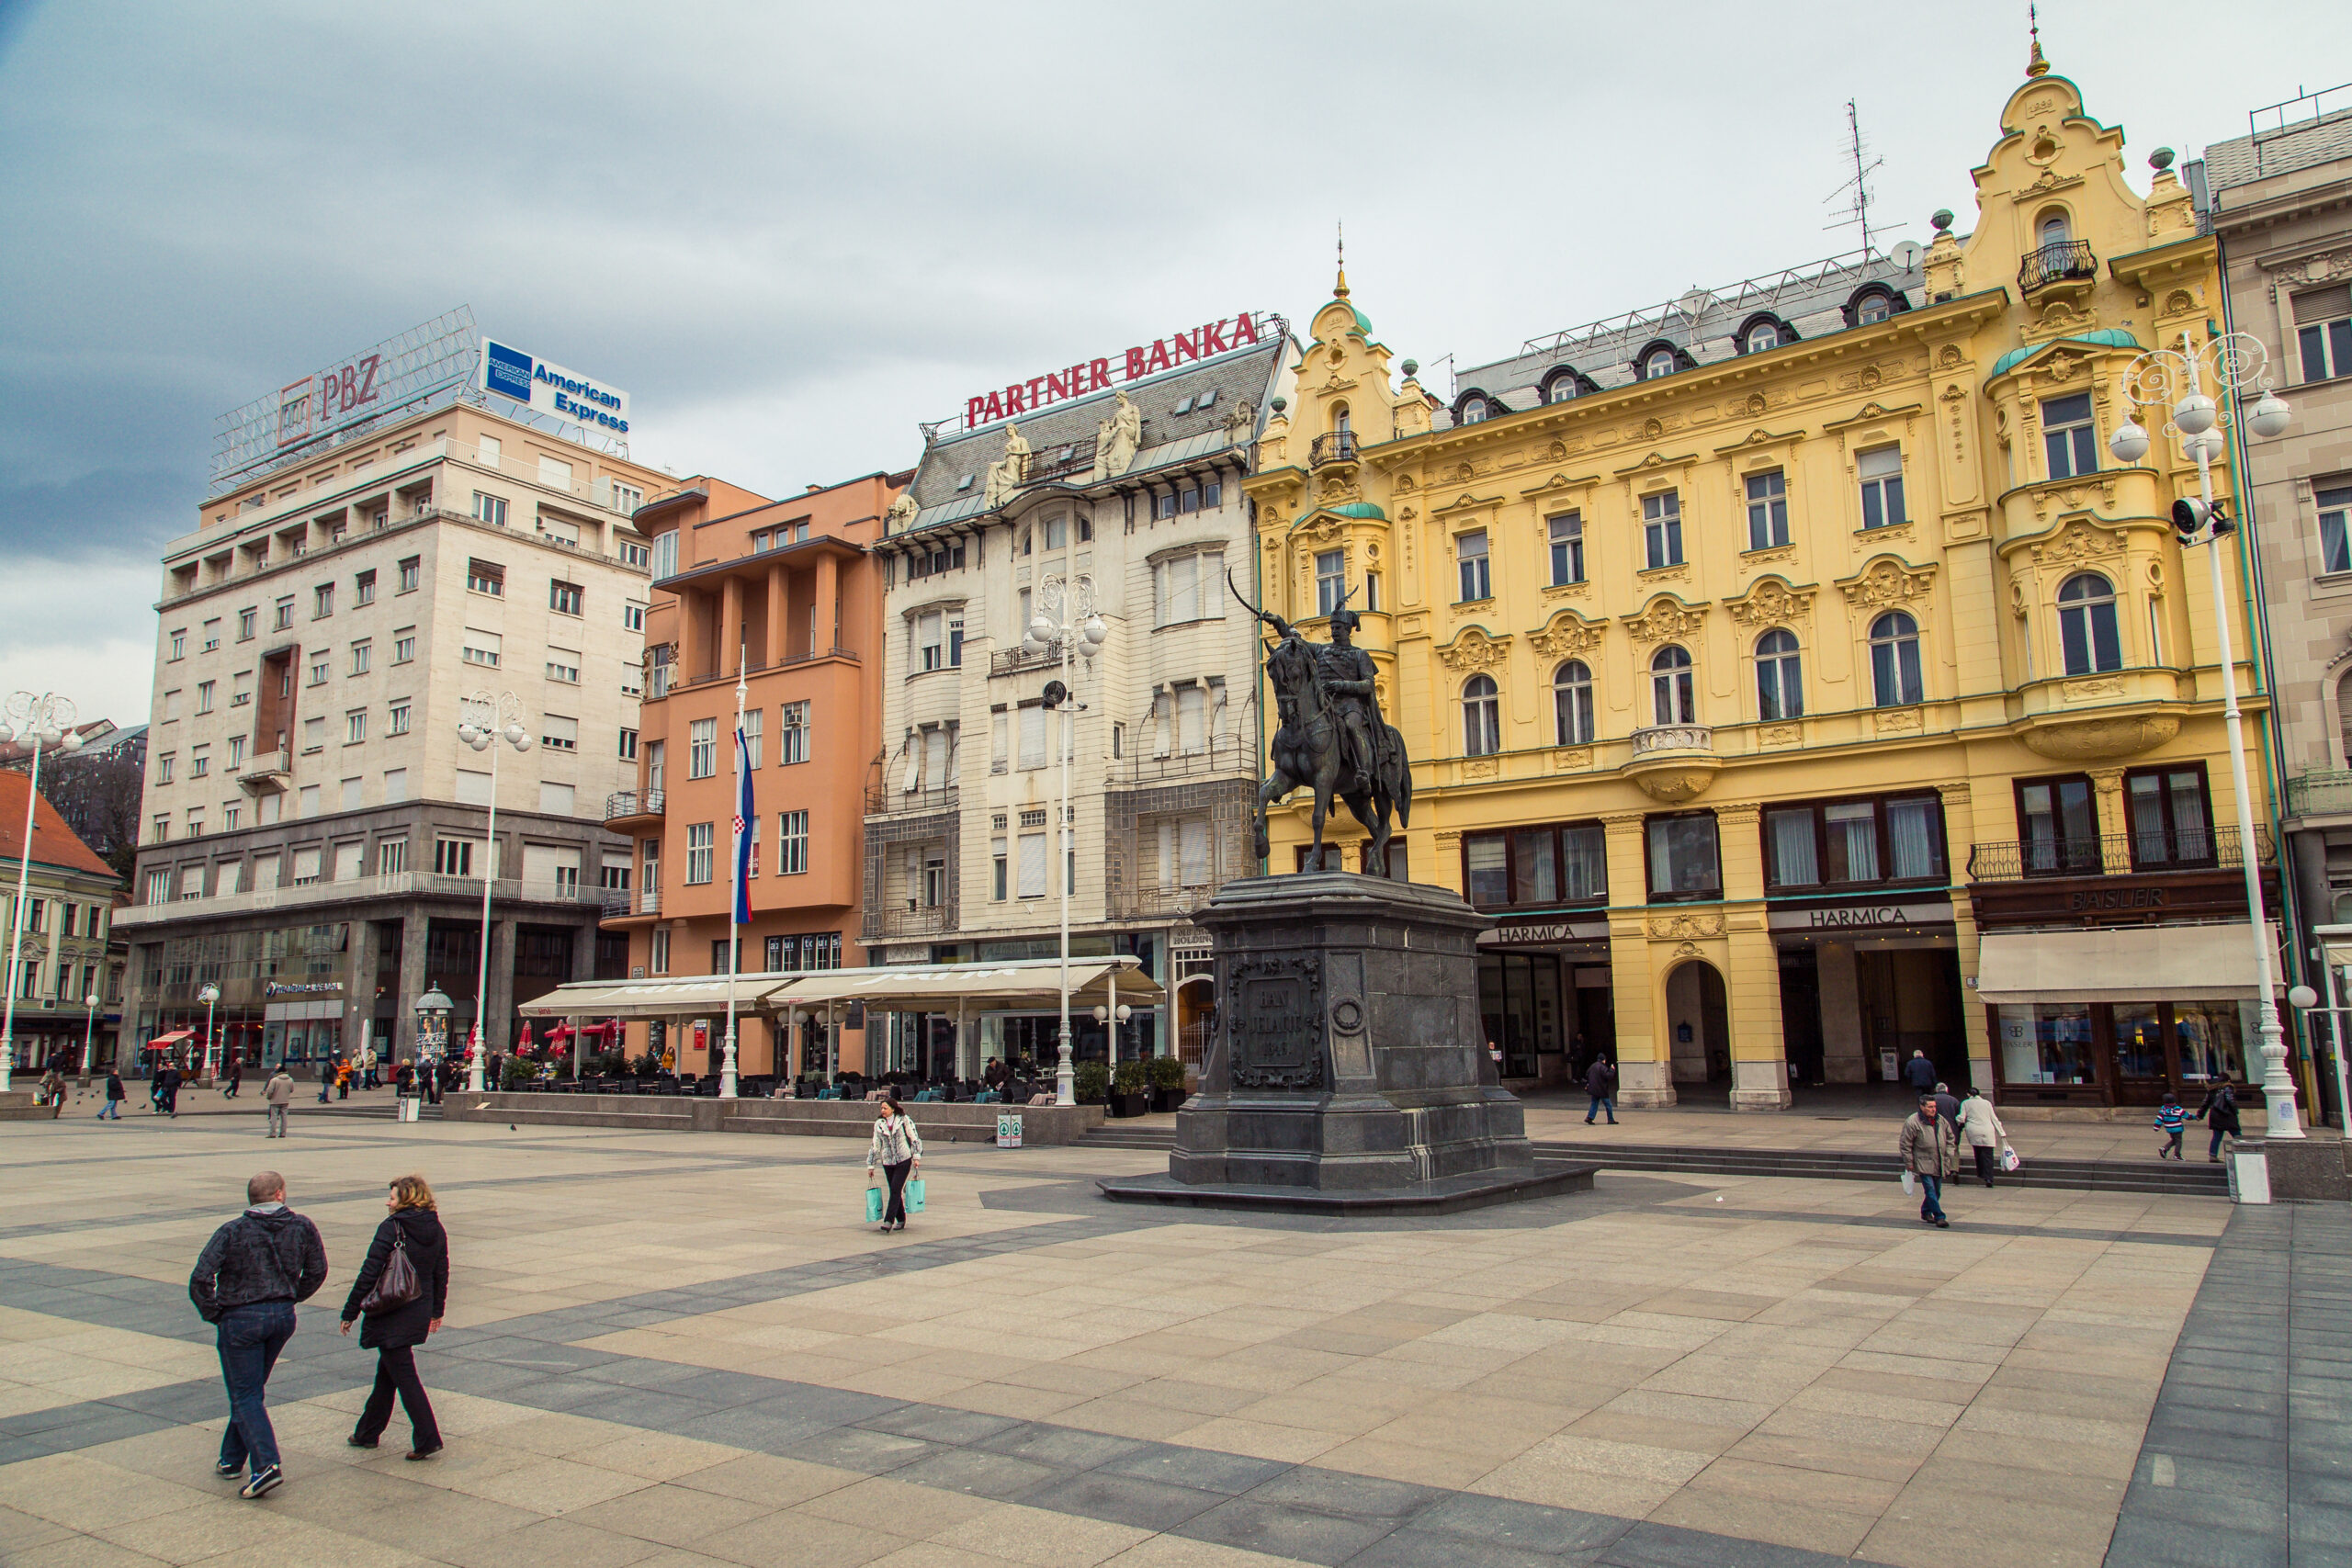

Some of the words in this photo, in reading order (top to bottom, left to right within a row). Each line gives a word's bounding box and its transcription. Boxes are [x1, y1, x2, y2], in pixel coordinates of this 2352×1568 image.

[489, 357, 531, 380] AMERICAN
[494, 368, 532, 388] EXPRESS
[967, 357, 1113, 428] PARTNER
[1125, 311, 1258, 381] BANKA
[320, 354, 380, 422] PBZ
[534, 364, 622, 411] American
[555, 392, 629, 434] Express
[2071, 888, 2165, 910] BASLER
[1810, 908, 1908, 927] HARMICA
[1498, 925, 1576, 942] HARMICA
[1260, 990, 1288, 1008] BAN
